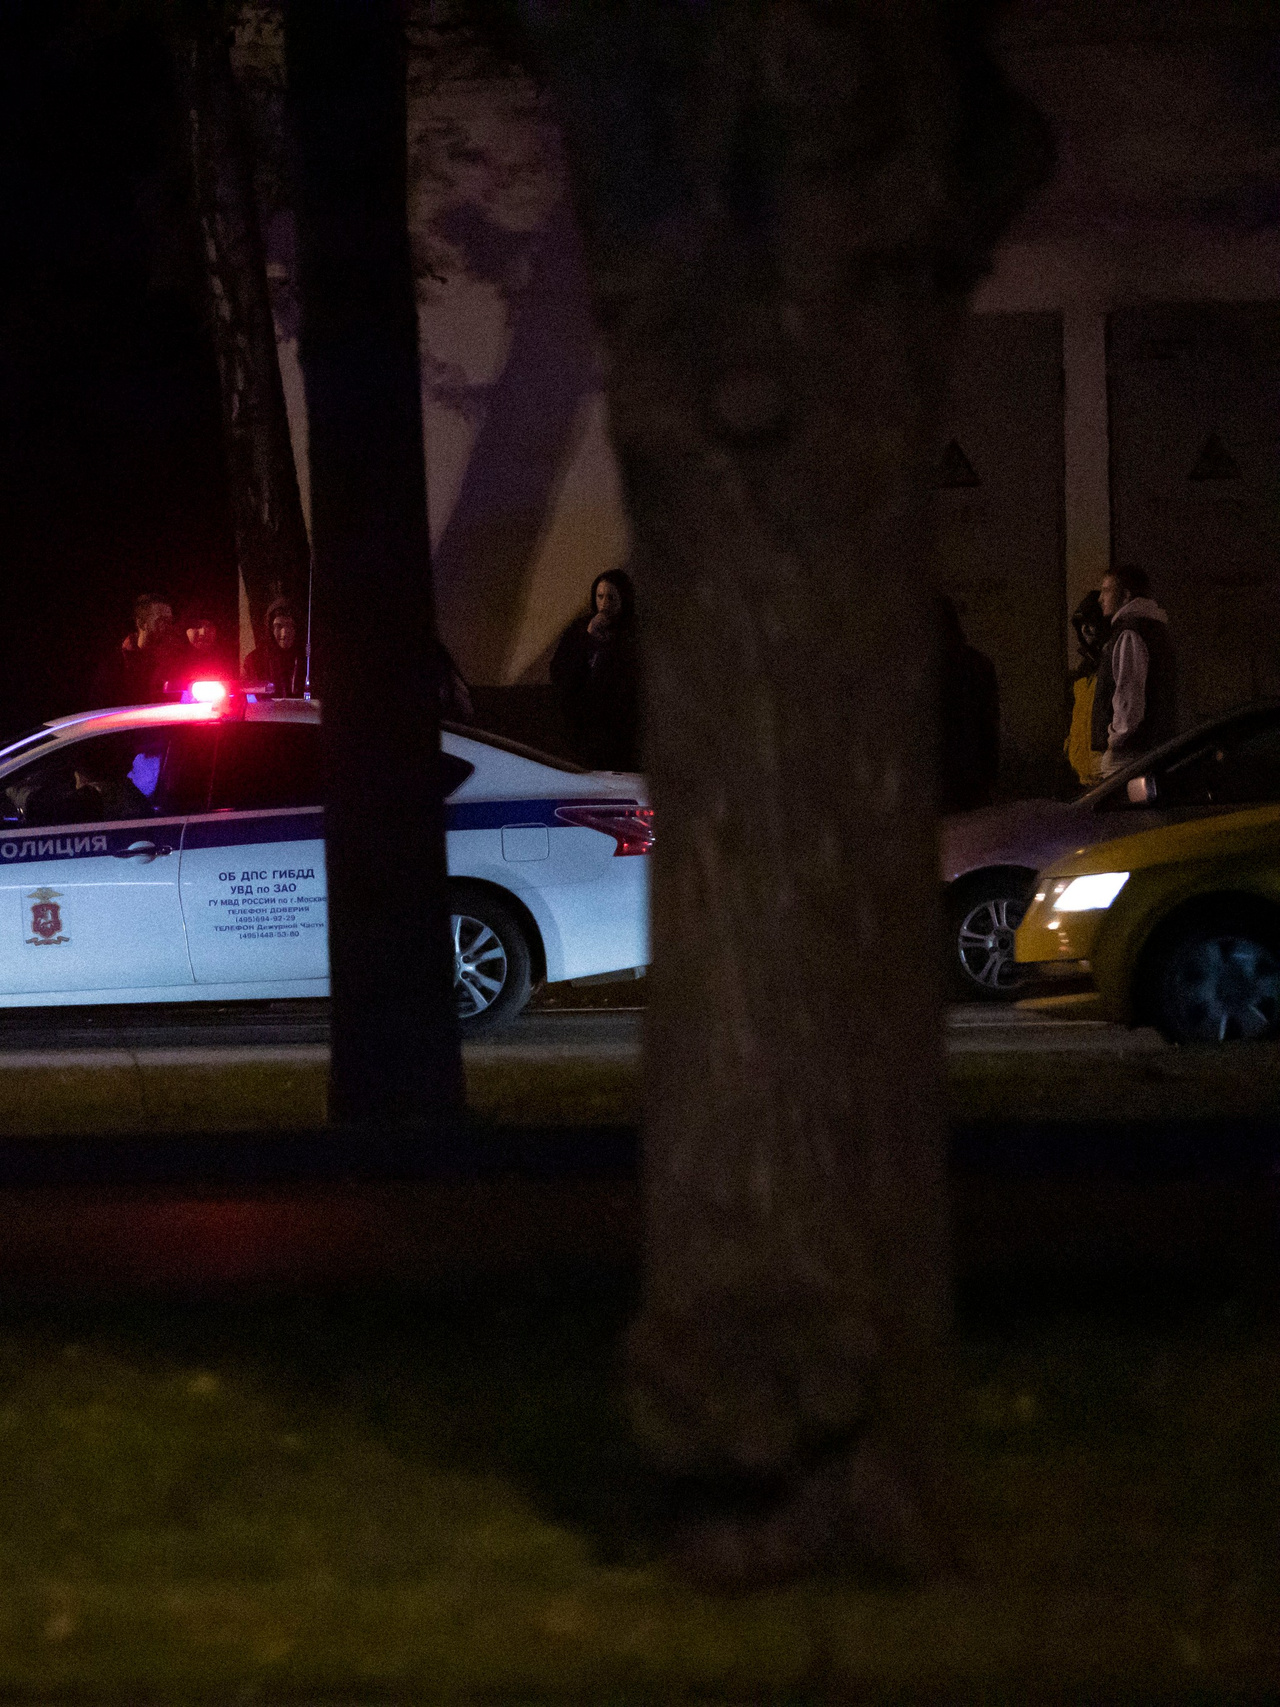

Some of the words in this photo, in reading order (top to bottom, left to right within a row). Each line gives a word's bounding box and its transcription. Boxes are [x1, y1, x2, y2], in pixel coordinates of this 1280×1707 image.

[218, 872, 236, 882] ОБ
[240, 870, 268, 882] ДПС
[272, 868, 315, 879] ГИБДД
[230, 885, 254, 895] УВД
[256, 886, 270, 894] по
[273, 883, 297, 893] ЗАО
[208, 899, 218, 907] ГУ
[220, 898, 240, 907] МВД
[242, 897, 276, 906] РОССИИ
